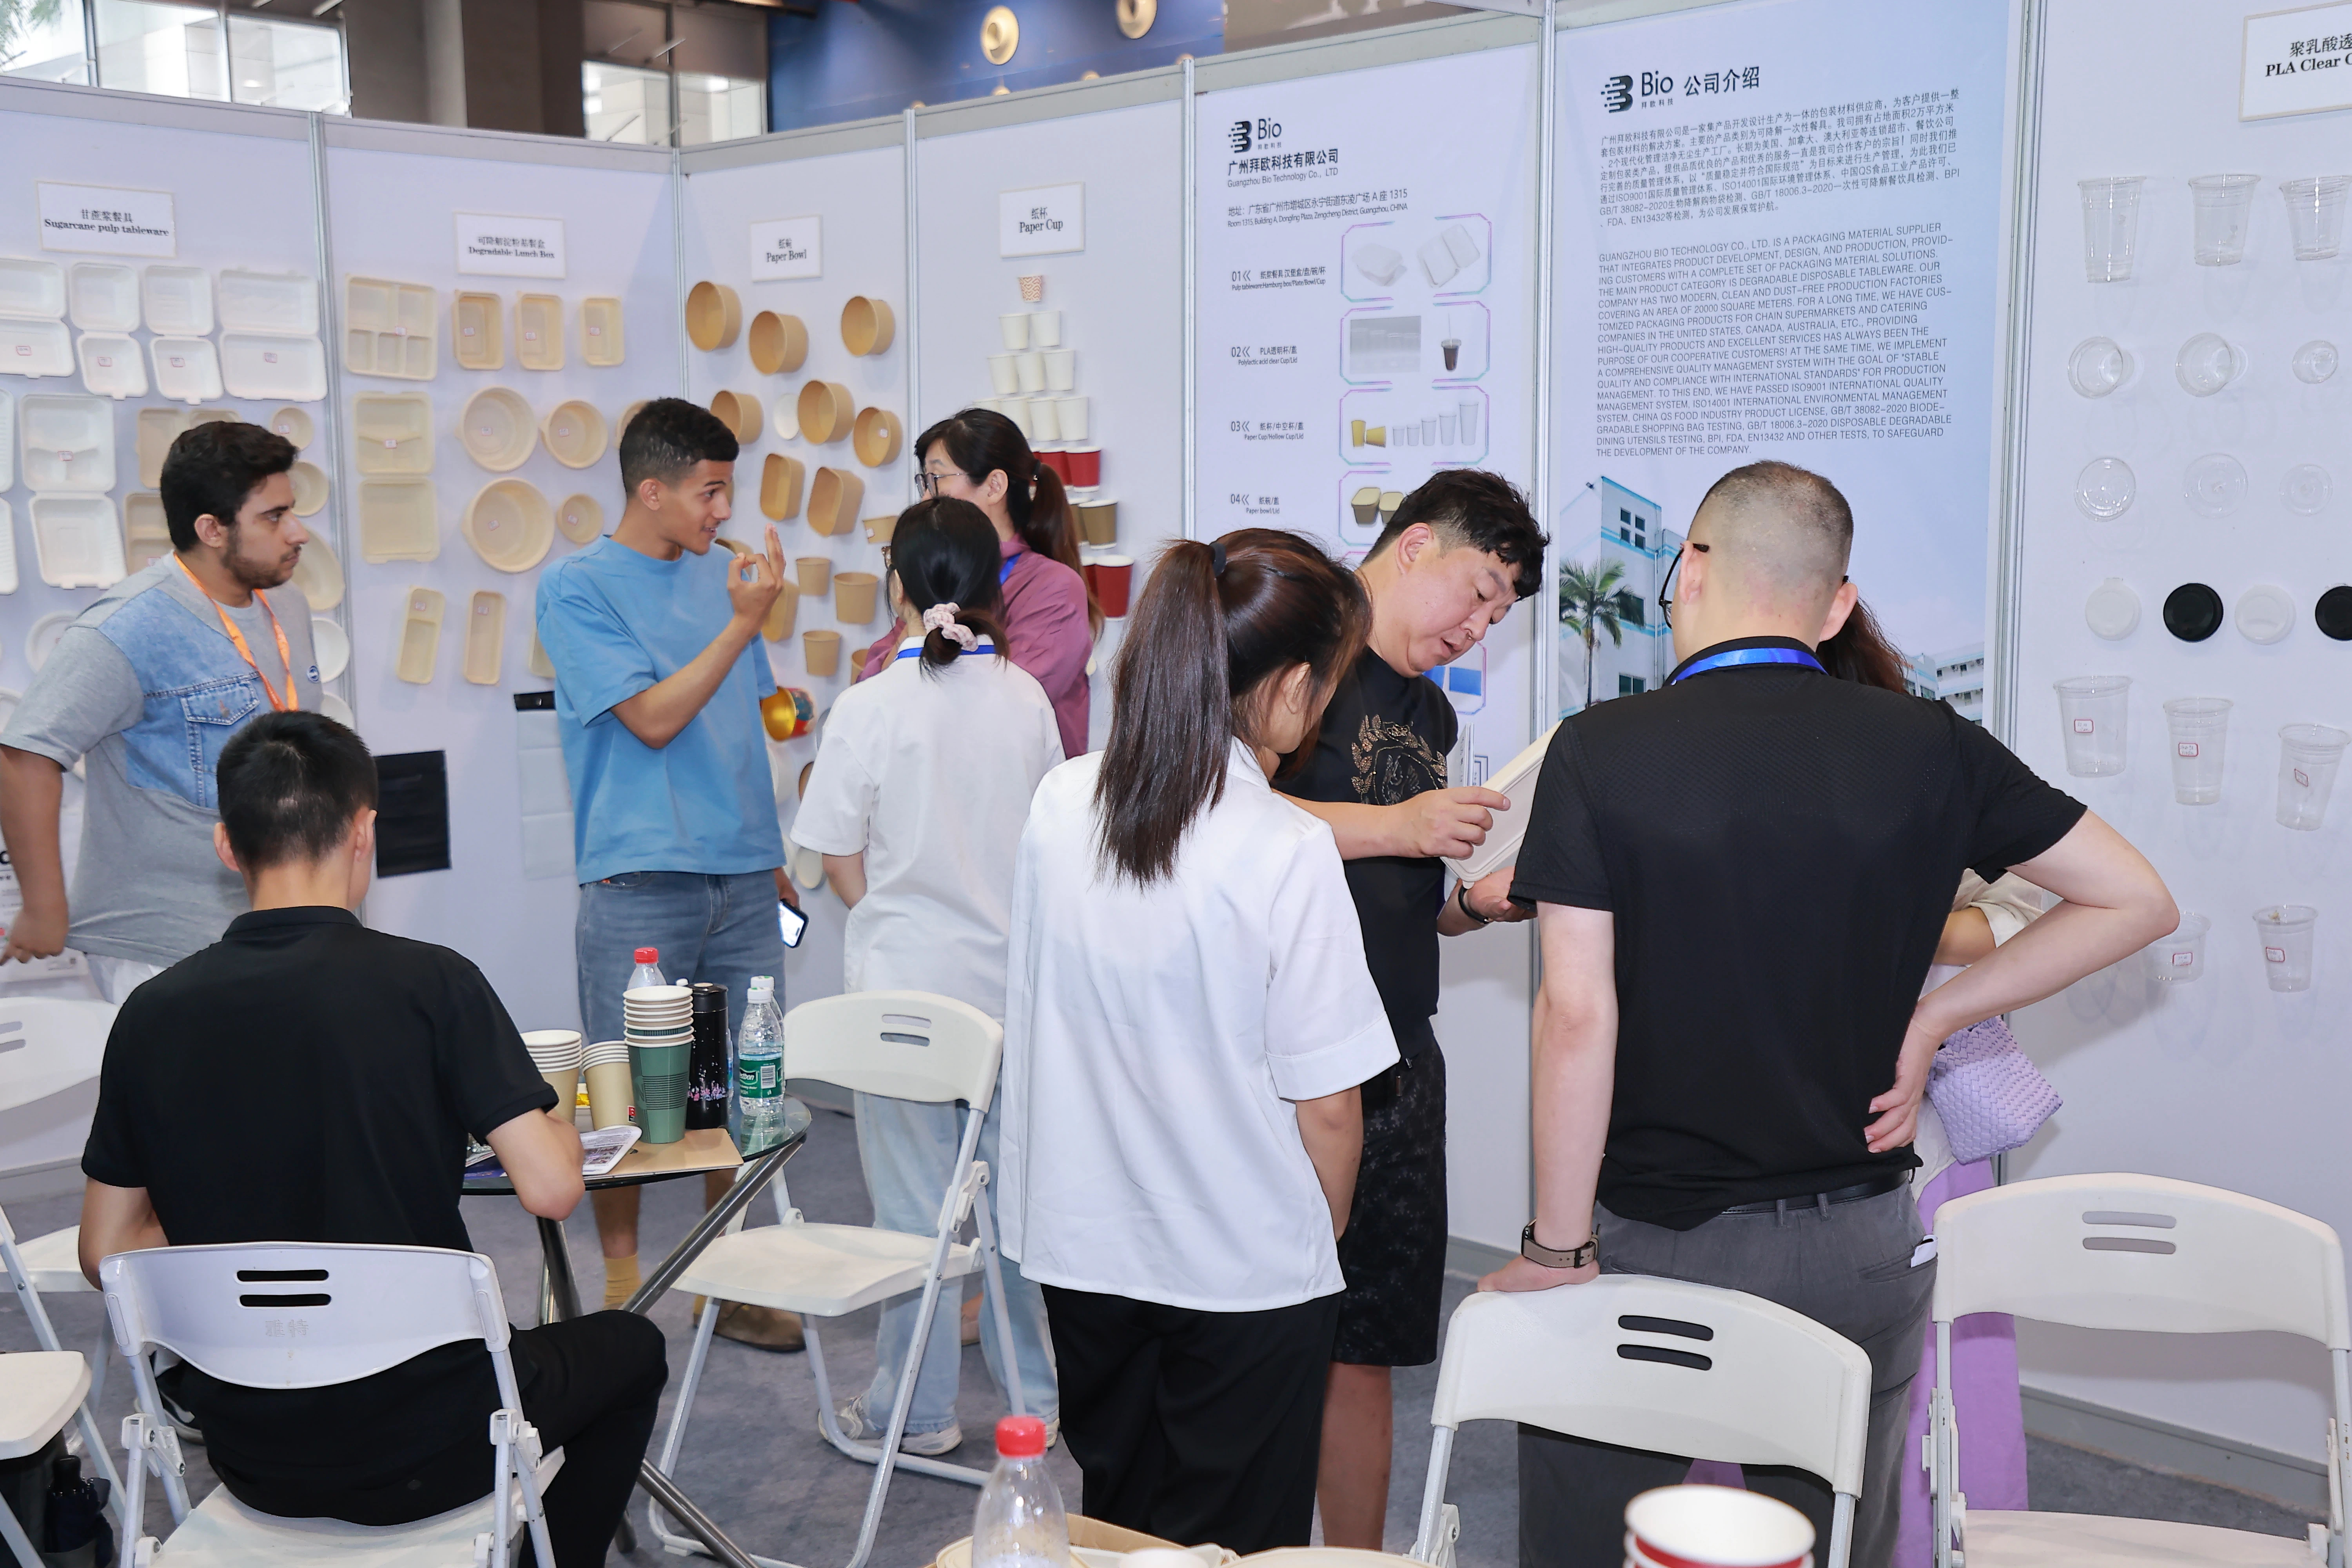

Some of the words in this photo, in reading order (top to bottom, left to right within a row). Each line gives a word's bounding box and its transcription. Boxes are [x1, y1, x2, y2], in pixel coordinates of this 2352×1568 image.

[2266, 61, 2296, 77] PLA
[2300, 57, 2341, 71] Clear
[1641, 70, 1674, 97] Bio
[1684, 65, 1759, 96] 公司介绍
[1642, 97, 1673, 109] 拜欧科技
[1257, 117, 1282, 140] Bio
[1228, 148, 1338, 176] 广州拜欧科技有限公司
[1227, 177, 1260, 187] Guangzhou
[1273, 172, 1307, 182] Technology
[1325, 167, 1338, 176] LTD
[1372, 192, 1377, 201] A
[1379, 191, 1387, 201] 座
[1390, 189, 1407, 199] 1315
[1031, 207, 1048, 220] 纸杯
[1390, 203, 1407, 211] CHINA
[1601, 205, 1618, 216] GB/T
[44, 218, 95, 230] Sugarcane
[98, 224, 119, 234] pulp
[122, 225, 169, 236] tableware
[1019, 219, 1044, 233] Paper
[1045, 219, 1063, 231] Cup
[1599, 250, 1651, 262] GUANGZHOU
[1654, 248, 1668, 257] BIO
[1671, 243, 1728, 256] TECHNOLOGY
[1731, 241, 1748, 250] CO.,
[1752, 239, 1769, 249] LTD.
[1774, 238, 1781, 246] IS
[1784, 237, 1789, 246] A
[1793, 231, 1845, 245] PACKAGING
[1849, 227, 1893, 240] MATERIAL
[1896, 223, 1941, 235] SUPPLIER
[468, 246, 512, 256] Degradable
[539, 250, 554, 258] Box
[766, 252, 786, 263] Paper
[788, 249, 807, 260] Bowl
[1599, 264, 1618, 274] THAT
[1622, 260, 1671, 272] INTEGRATES
[1674, 256, 1714, 267] PRODUCT
[1717, 250, 1781, 264] DEVELOPMENT,
[1785, 247, 1820, 258] DESIGN,
[1824, 245, 1842, 254] AND
[1846, 238, 1908, 252] PRODUCTION,
[1912, 235, 1953, 247] PROVID-
[1599, 276, 1613, 285] ING
[1616, 272, 1665, 284] CUSTOMERS
[1668, 270, 1688, 279] WITH
[1691, 270, 1696, 278] A
[1699, 266, 1744, 277] COMPLETE
[1747, 264, 1761, 273] SET
[1765, 262, 1776, 272] OF
[1780, 258, 1831, 270] PACKAGING
[1835, 254, 1879, 266] MATERIAL
[1882, 249, 1937, 262] SOLUTIONS.
[1232, 270, 1241, 282] 01
[1283, 278, 1326, 288] box/Plate/Bowl/Cup
[1599, 288, 1613, 296] THE
[1617, 286, 1636, 295] MAIN
[1639, 283, 1677, 293] PRODUCT
[1681, 279, 1726, 290] CATEGORY
[1730, 278, 1737, 287] IS
[1740, 273, 1797, 286] DEGRADABLE
[1801, 269, 1856, 281] DISPOSABLE
[1859, 264, 1916, 276] TABLEWARE.
[1920, 261, 1940, 272] OUR
[1598, 343, 1657, 354] HIGH-QUALITY
[1661, 340, 1705, 351] PRODUCTS
[1708, 339, 1725, 348] AND
[1728, 336, 1776, 347] EXCELLENT
[1779, 332, 1820, 344] SERVICES
[1824, 332, 1841, 341] HAS
[1845, 329, 1881, 340] ALWAYS
[1884, 328, 1908, 338] BEEN
[1911, 327, 1929, 336] THE
[1231, 347, 1241, 358] 02
[1260, 345, 1297, 355] PLA透明杯/盖
[1597, 414, 1630, 423] SYSTEM,
[1633, 413, 1658, 421] CHINA
[1675, 411, 1698, 420] FOOD
[1701, 410, 1742, 419] INDUSTRY
[1745, 408, 1786, 418] PRODUCT
[1789, 406, 1827, 416] LICENSE,
[1831, 405, 1851, 415] GB/T
[1855, 404, 1907, 414] 38082-2020
[1910, 402, 1944, 412] BIODE-
[1230, 421, 1241, 432] 03
[1259, 421, 1303, 431] 纸杯/中空杯/盖
[1597, 437, 1624, 445] DINING
[1628, 436, 1665, 445] UTENSILS
[1669, 434, 1704, 443] TESTING,
[1708, 434, 1723, 443] BPI,
[1726, 434, 1744, 443] FDA,
[1748, 433, 1784, 441] EN13432
[1787, 431, 1805, 441] AND
[1808, 430, 1837, 440] OTHER
[1840, 430, 1869, 439] TESTS,
[1873, 429, 1884, 438] TO
[1887, 427, 1943, 438] SAFEGUARD
[1597, 448, 1611, 457] THE
[1614, 447, 1673, 456] DEVELOPMENT
[1690, 446, 1704, 455] THE
[1708, 445, 1751, 454] COMPANY.
[1230, 493, 1240, 505] 04
